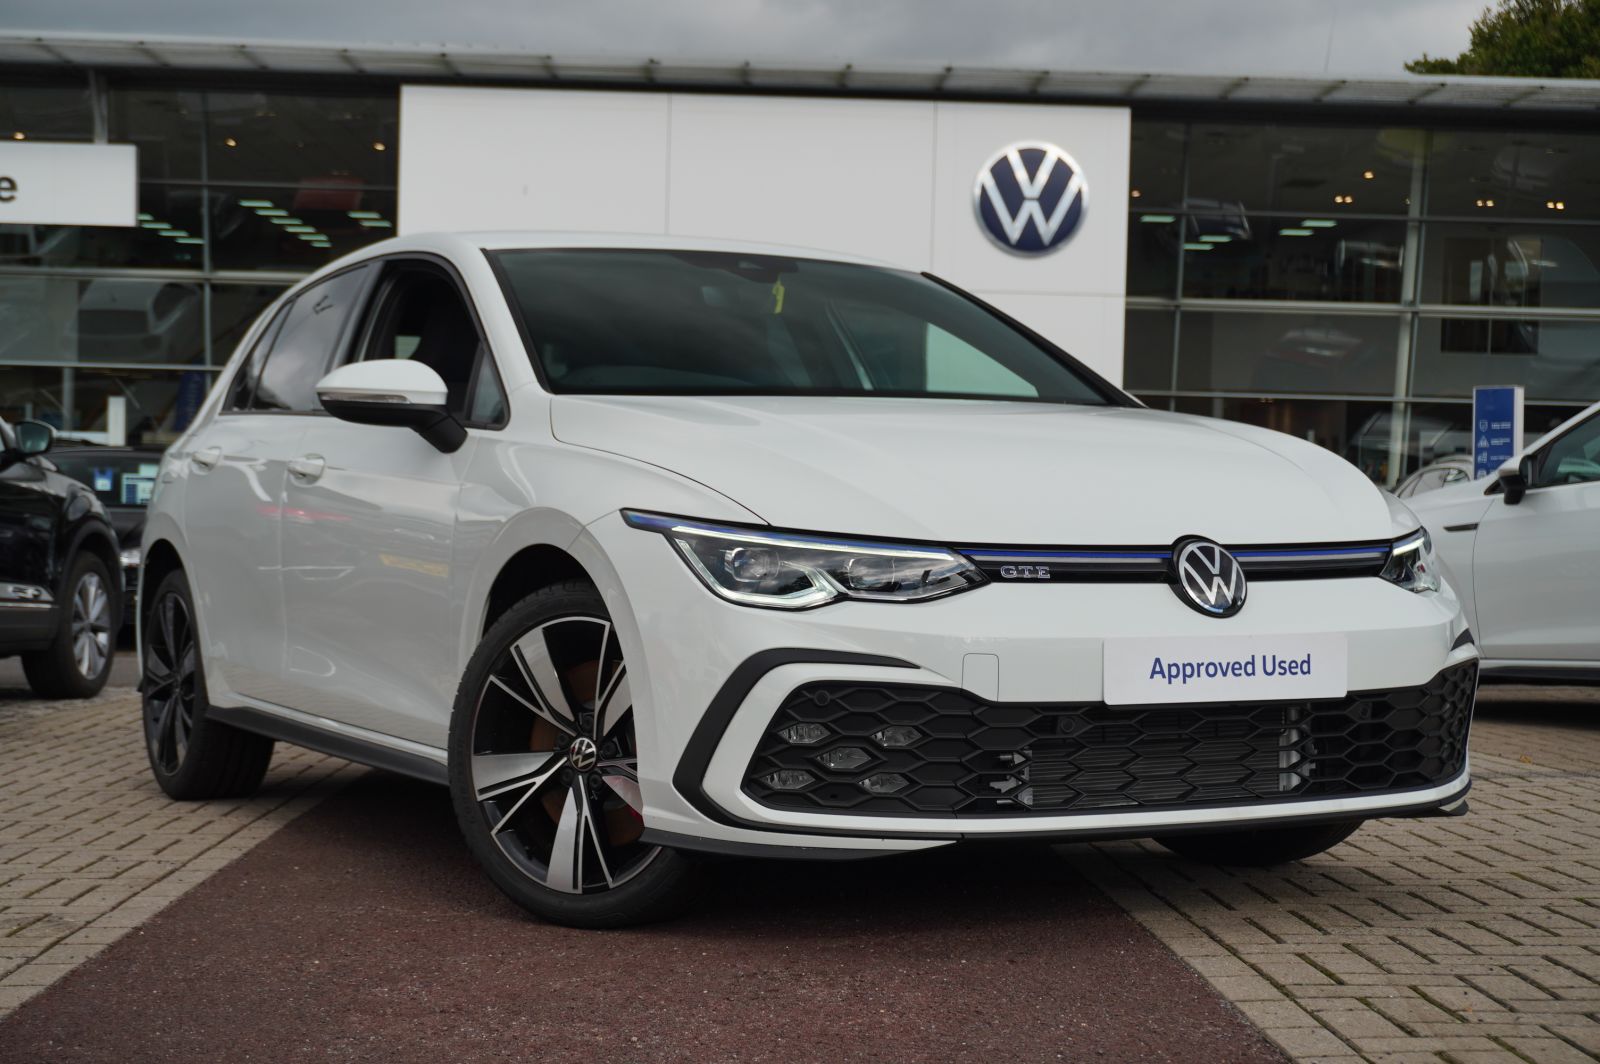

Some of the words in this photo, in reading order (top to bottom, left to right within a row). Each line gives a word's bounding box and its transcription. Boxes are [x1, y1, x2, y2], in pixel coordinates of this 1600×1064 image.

[1000, 565, 1051, 579] GTE
[1149, 654, 1256, 685] Approved
[1262, 653, 1312, 678] Used
